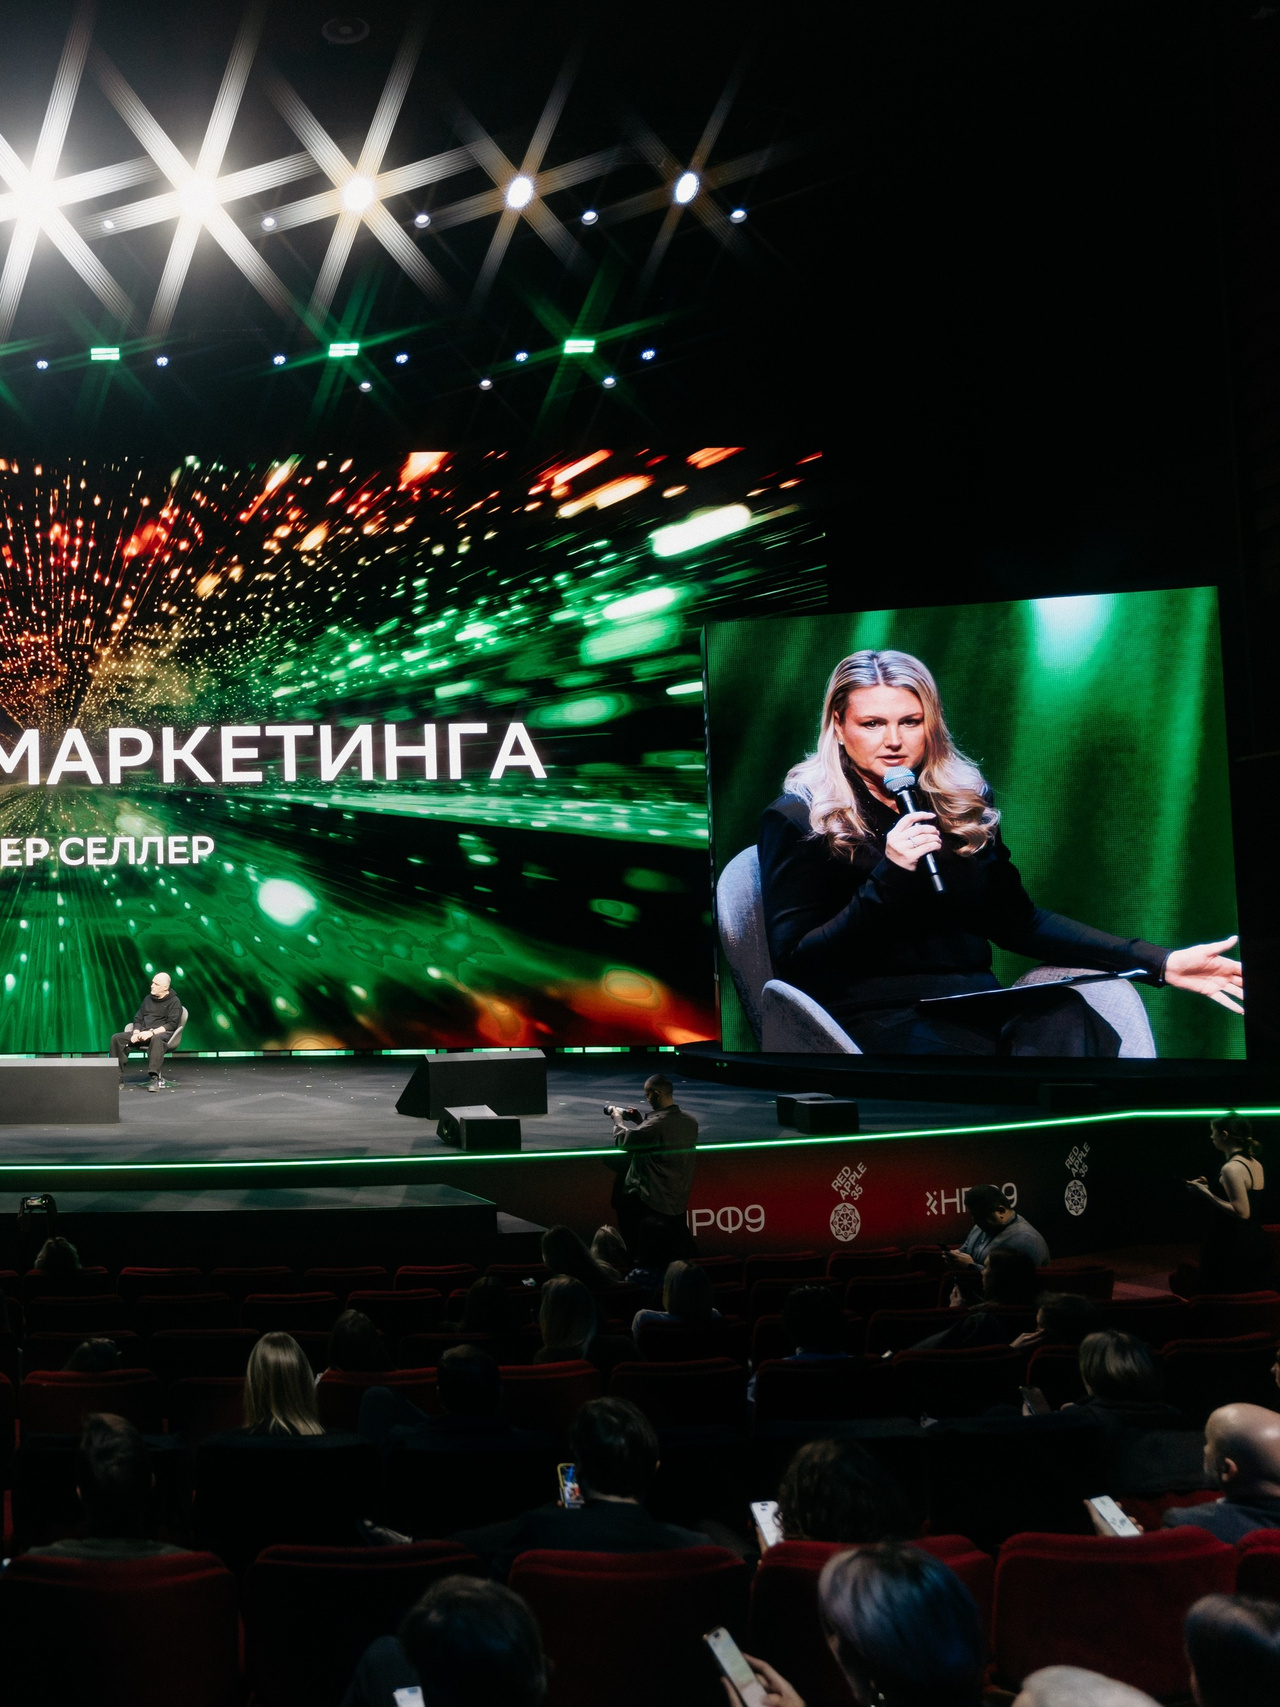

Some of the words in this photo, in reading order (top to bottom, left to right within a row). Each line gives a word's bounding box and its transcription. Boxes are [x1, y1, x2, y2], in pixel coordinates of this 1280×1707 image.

[59, 835, 216, 866] СЕЛЛЕР
[1065, 1145, 1080, 1170] RED
[1071, 1141, 1091, 1178] APPLE
[831, 1165, 851, 1192] RED
[840, 1161, 867, 1201] APPLE
[851, 1183, 864, 1201] 35
[687, 1204, 765, 1236] РФ9
